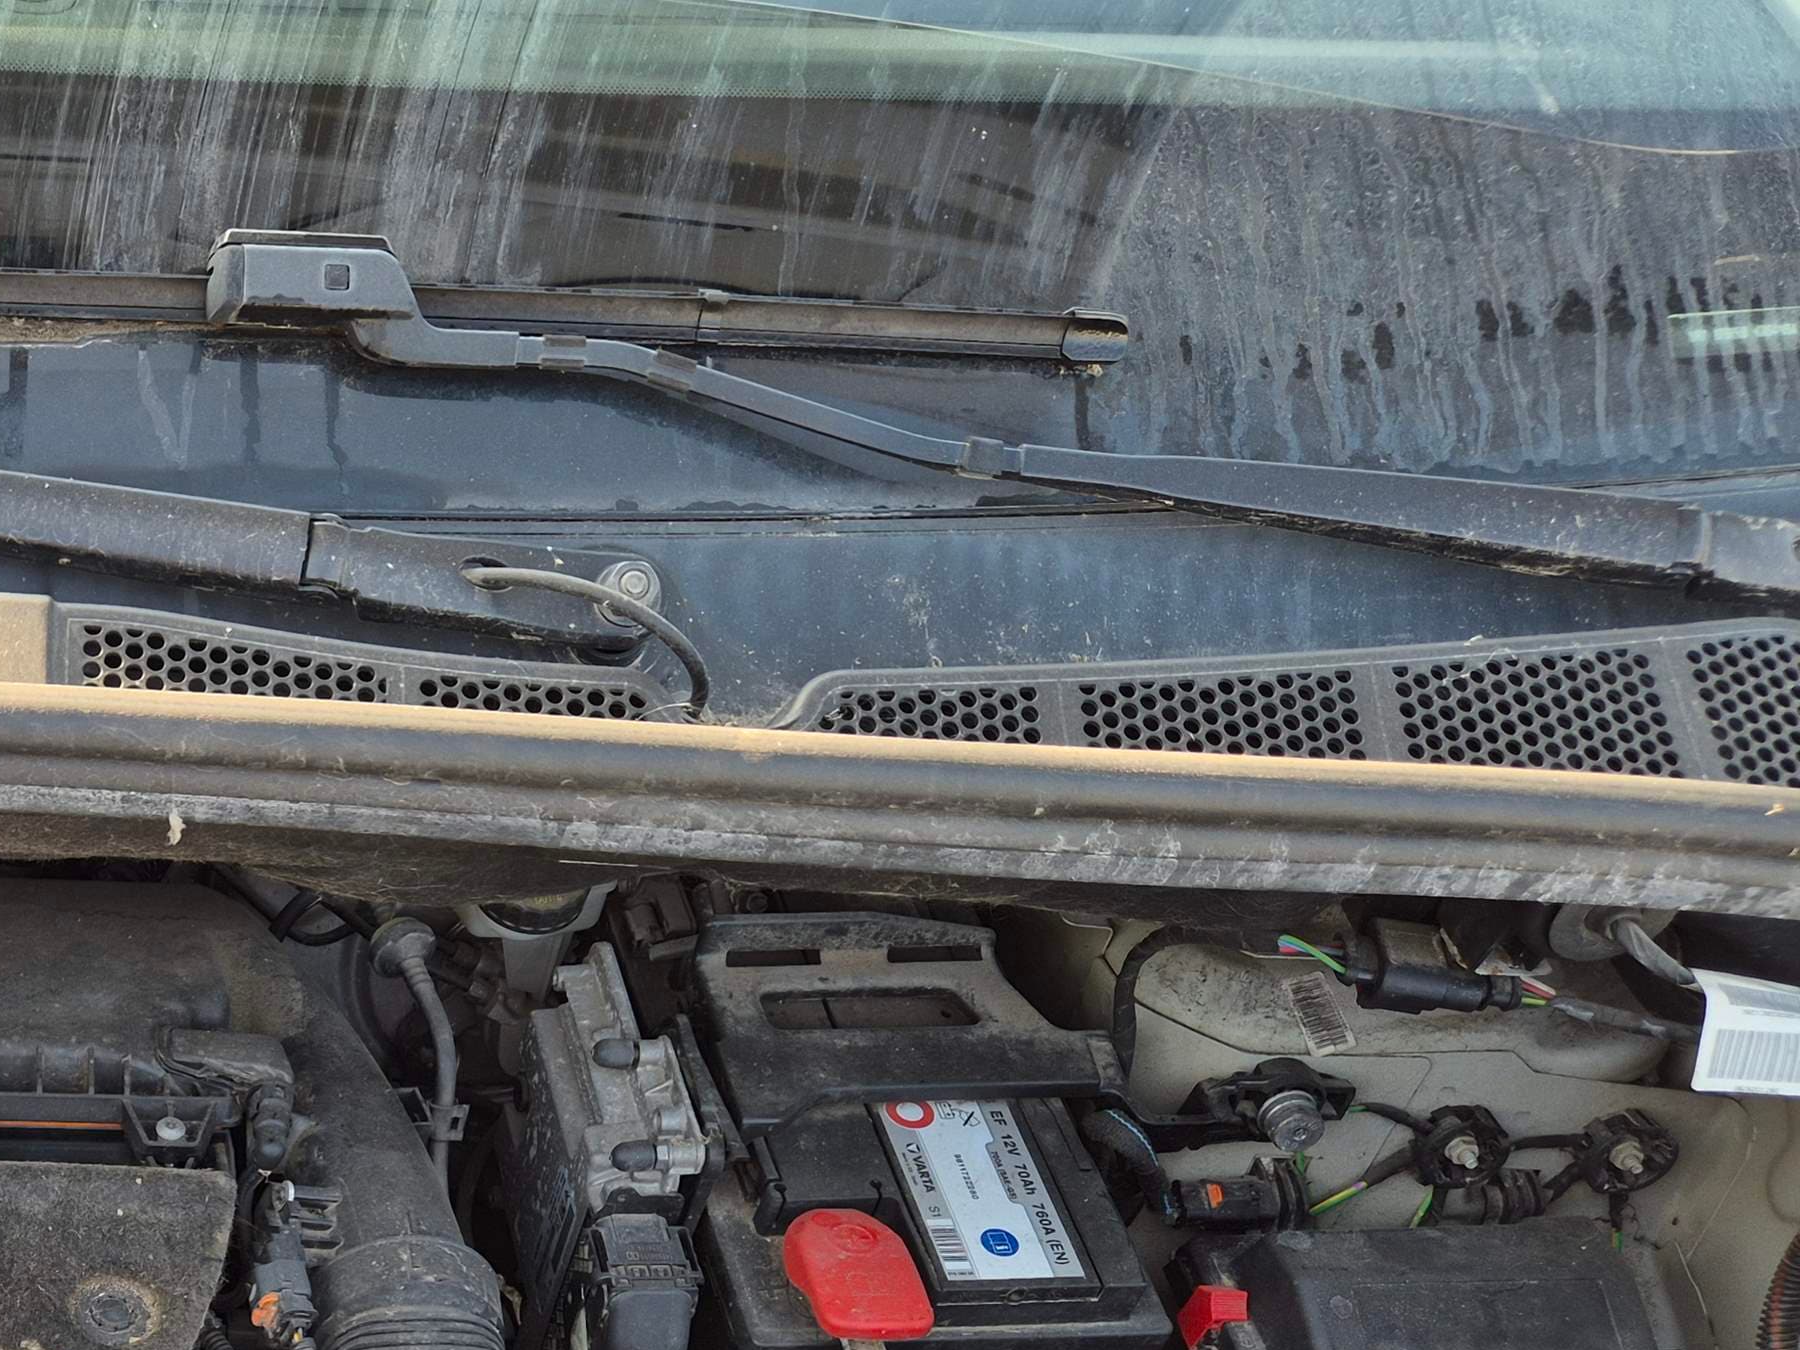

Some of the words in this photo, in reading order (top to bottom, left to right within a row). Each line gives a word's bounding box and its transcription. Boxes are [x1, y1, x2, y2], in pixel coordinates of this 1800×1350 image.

[913, 1155, 935, 1193] VARTA
[990, 1110, 1007, 1127] EF
[1001, 1134, 1020, 1156] 12V
[1015, 1163, 1037, 1195] 70Ah
[1032, 1203, 1056, 1236] 760A
[1046, 1239, 1070, 1265] (EN)
[928, 1205, 942, 1217] S1
